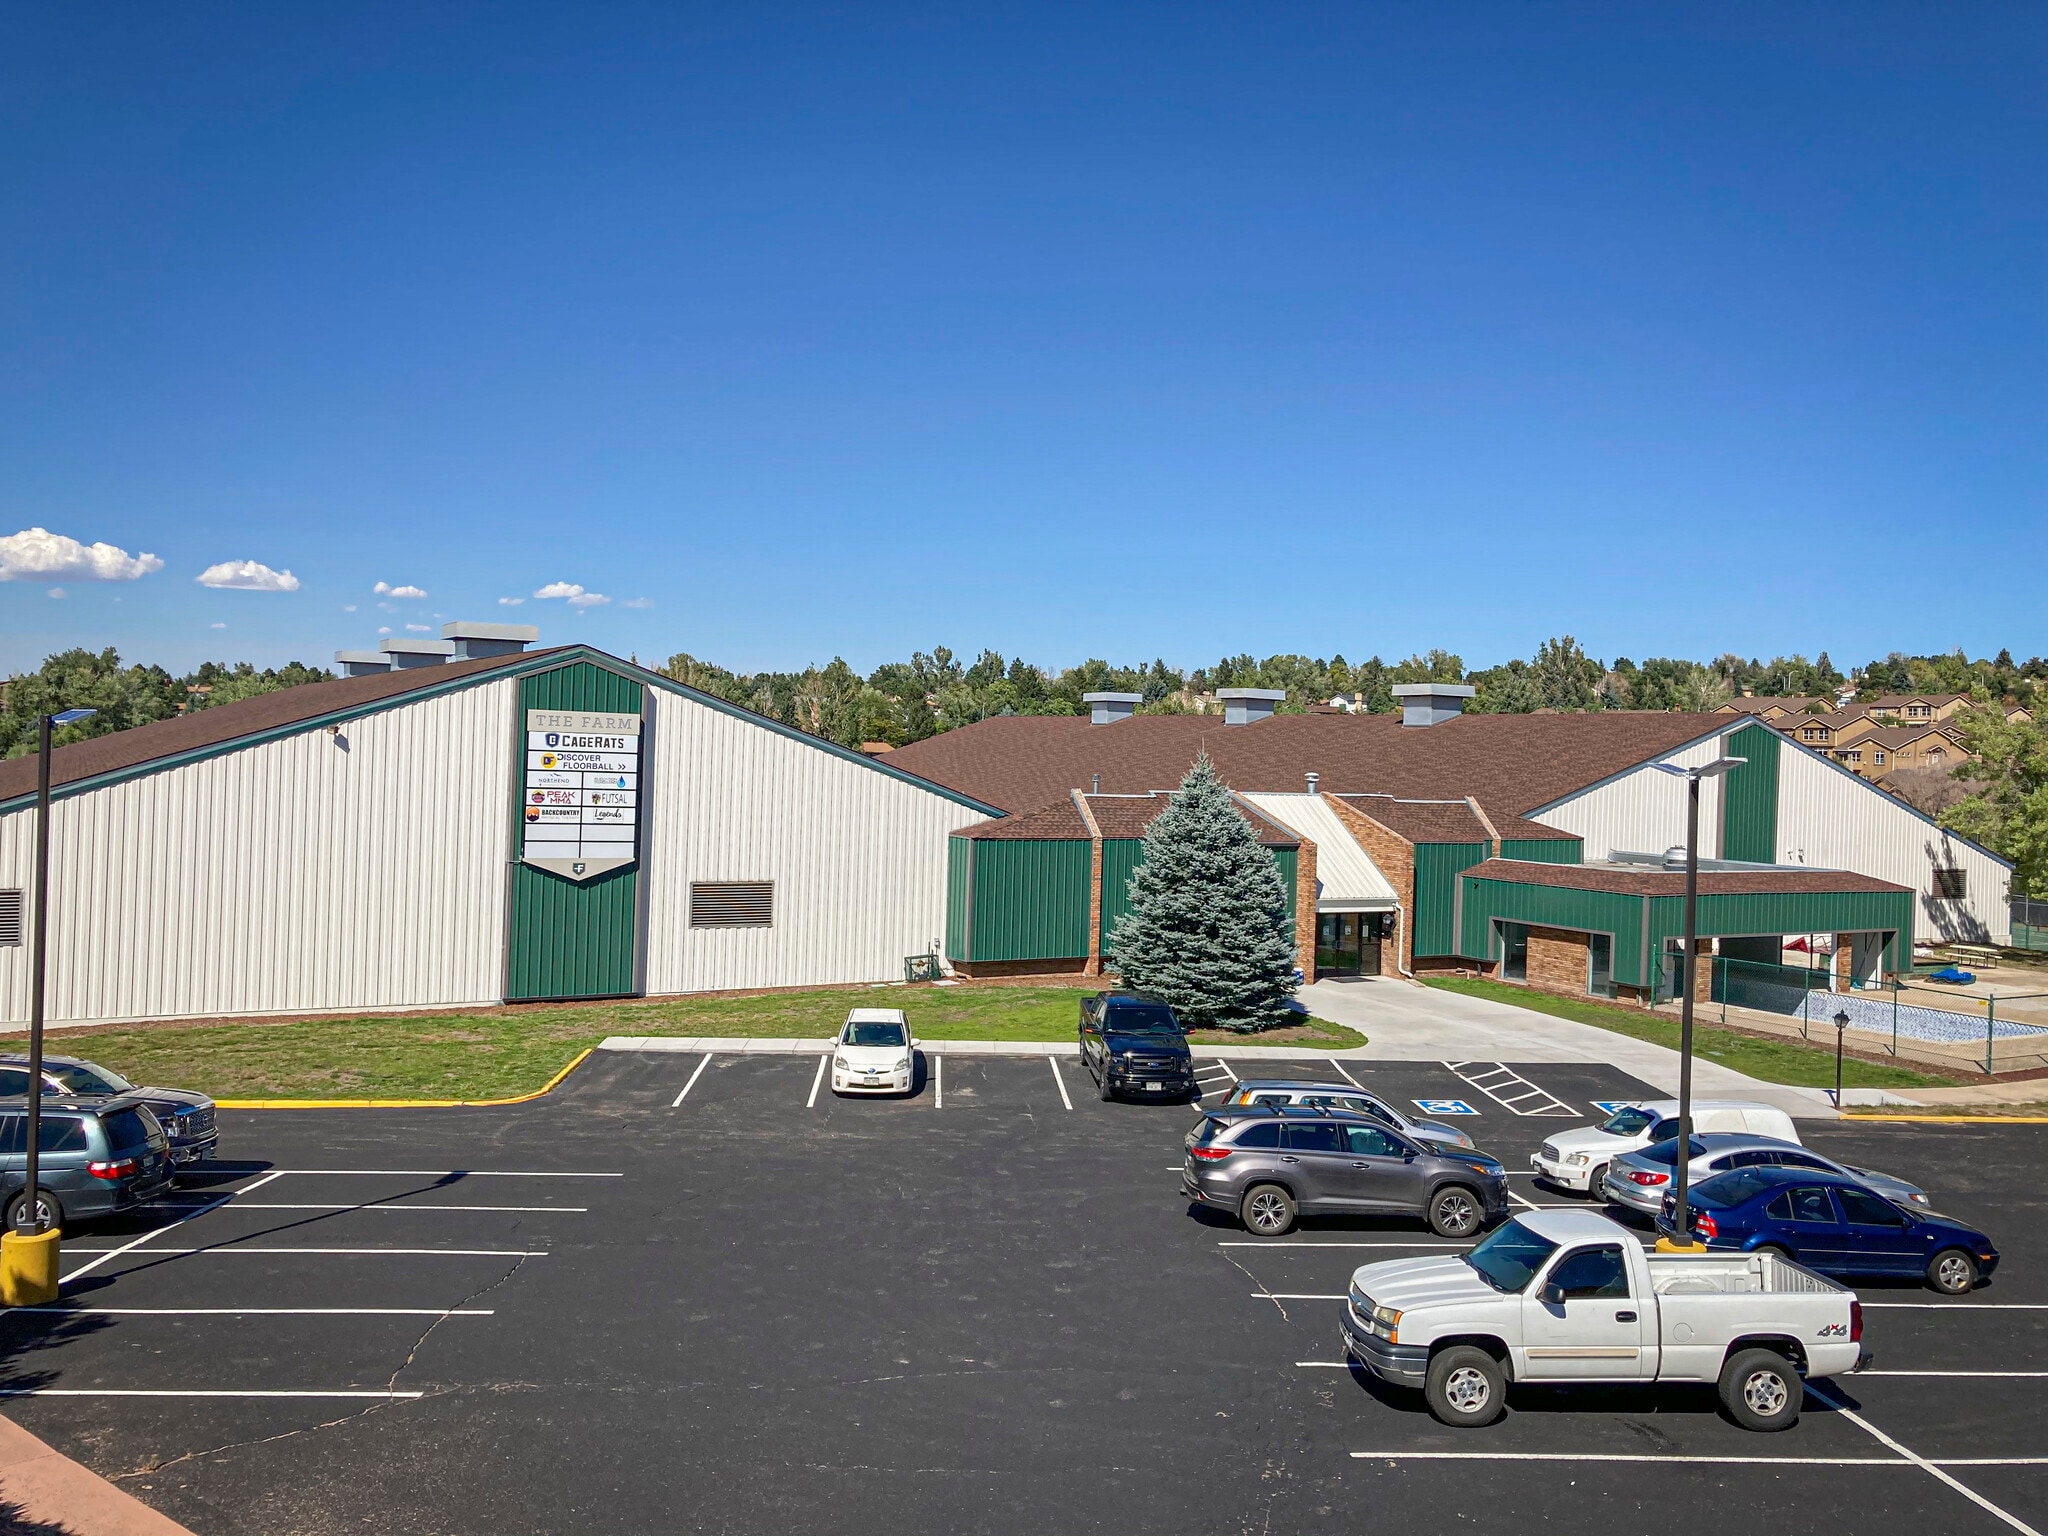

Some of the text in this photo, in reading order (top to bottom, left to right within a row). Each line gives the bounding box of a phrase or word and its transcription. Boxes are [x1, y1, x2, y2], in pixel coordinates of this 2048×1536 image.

[536, 715, 632, 730] THE FARM
[557, 753, 601, 762] DISCOVER
[563, 762, 614, 770] FLOORBALL
[547, 790, 576, 799] PEAK
[601, 793, 627, 804] FUTSAL
